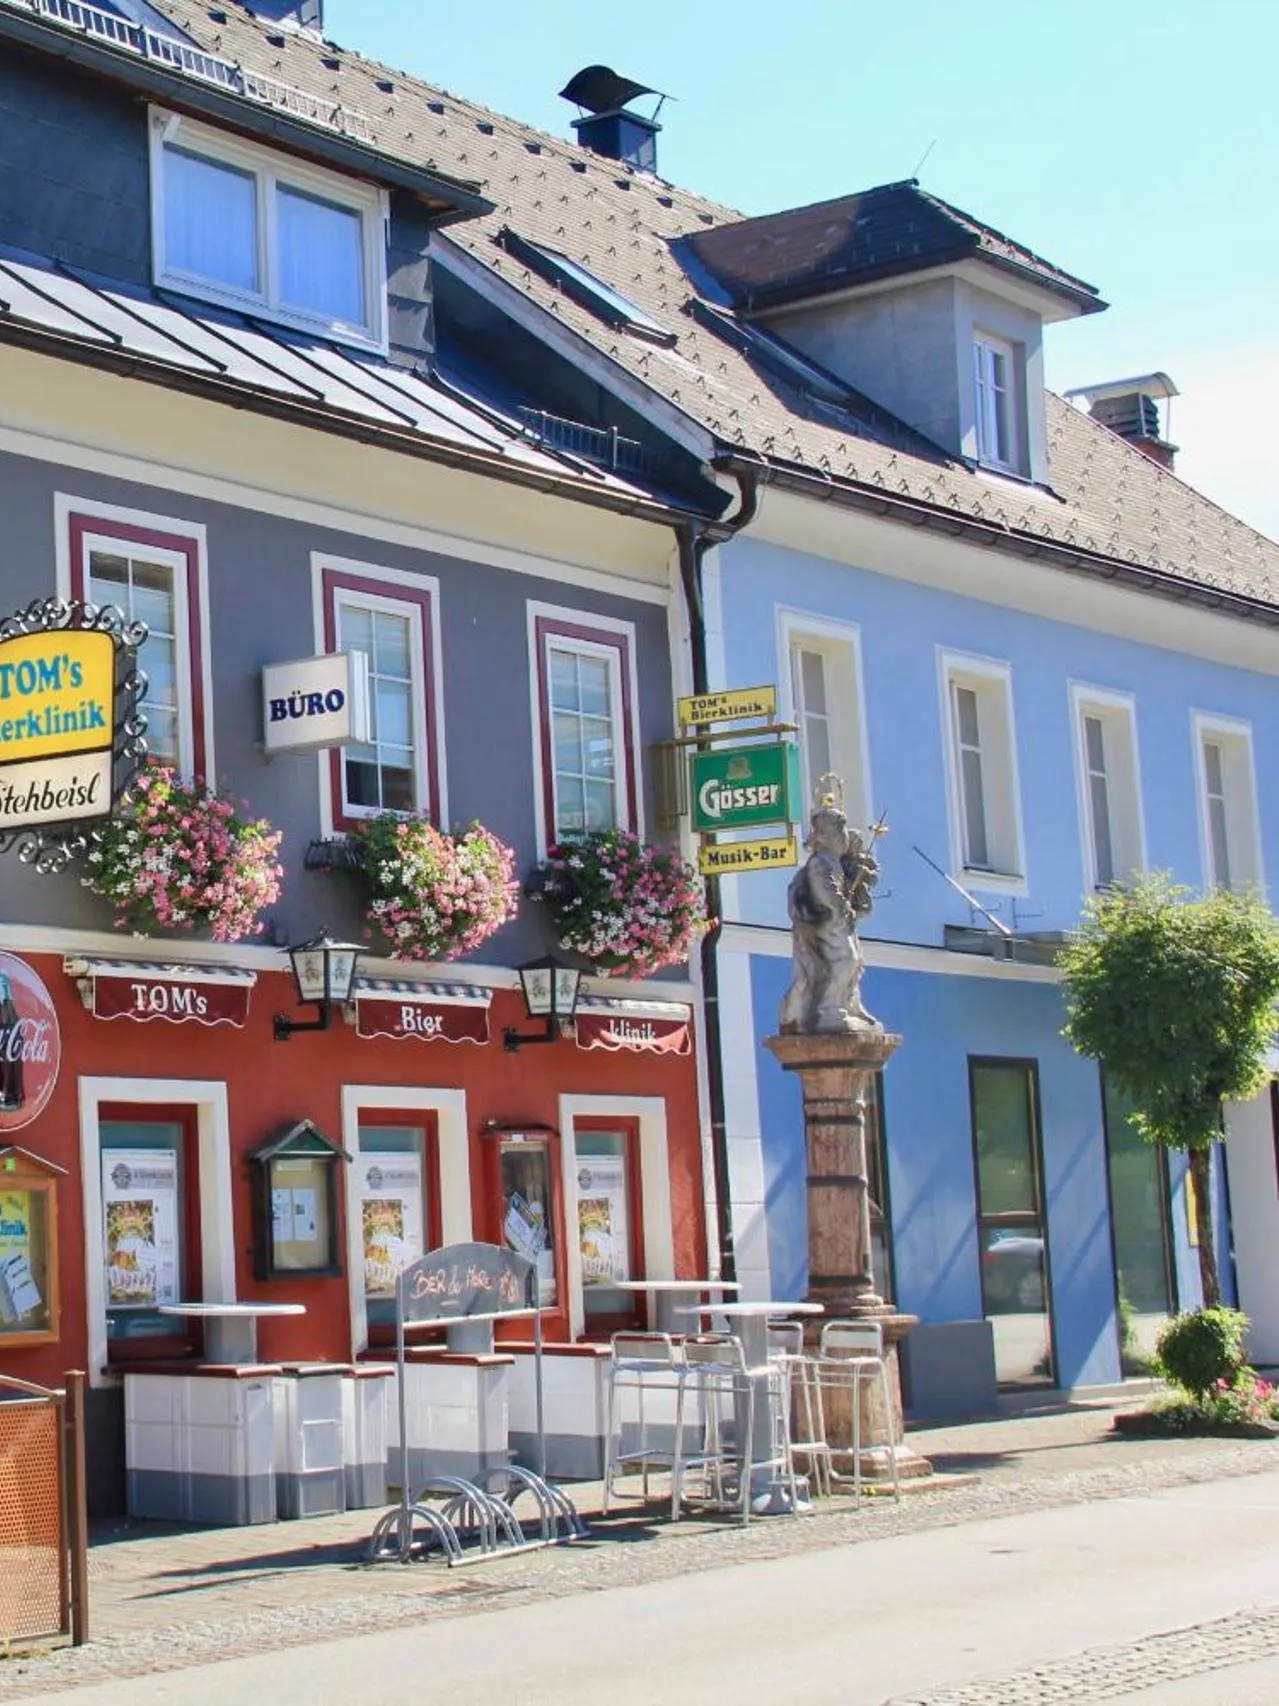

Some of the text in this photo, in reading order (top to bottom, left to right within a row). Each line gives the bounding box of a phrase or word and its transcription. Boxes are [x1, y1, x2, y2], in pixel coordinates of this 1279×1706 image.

[269, 689, 345, 722] BÜRO
[691, 704, 763, 721] Bierklinik
[699, 779, 780, 818] Gösser
[707, 847, 787, 866] Musik-Bar
[131, 984, 207, 1014] TOM's
[401, 1006, 443, 1035] Bier
[610, 1020, 656, 1045] klinik
